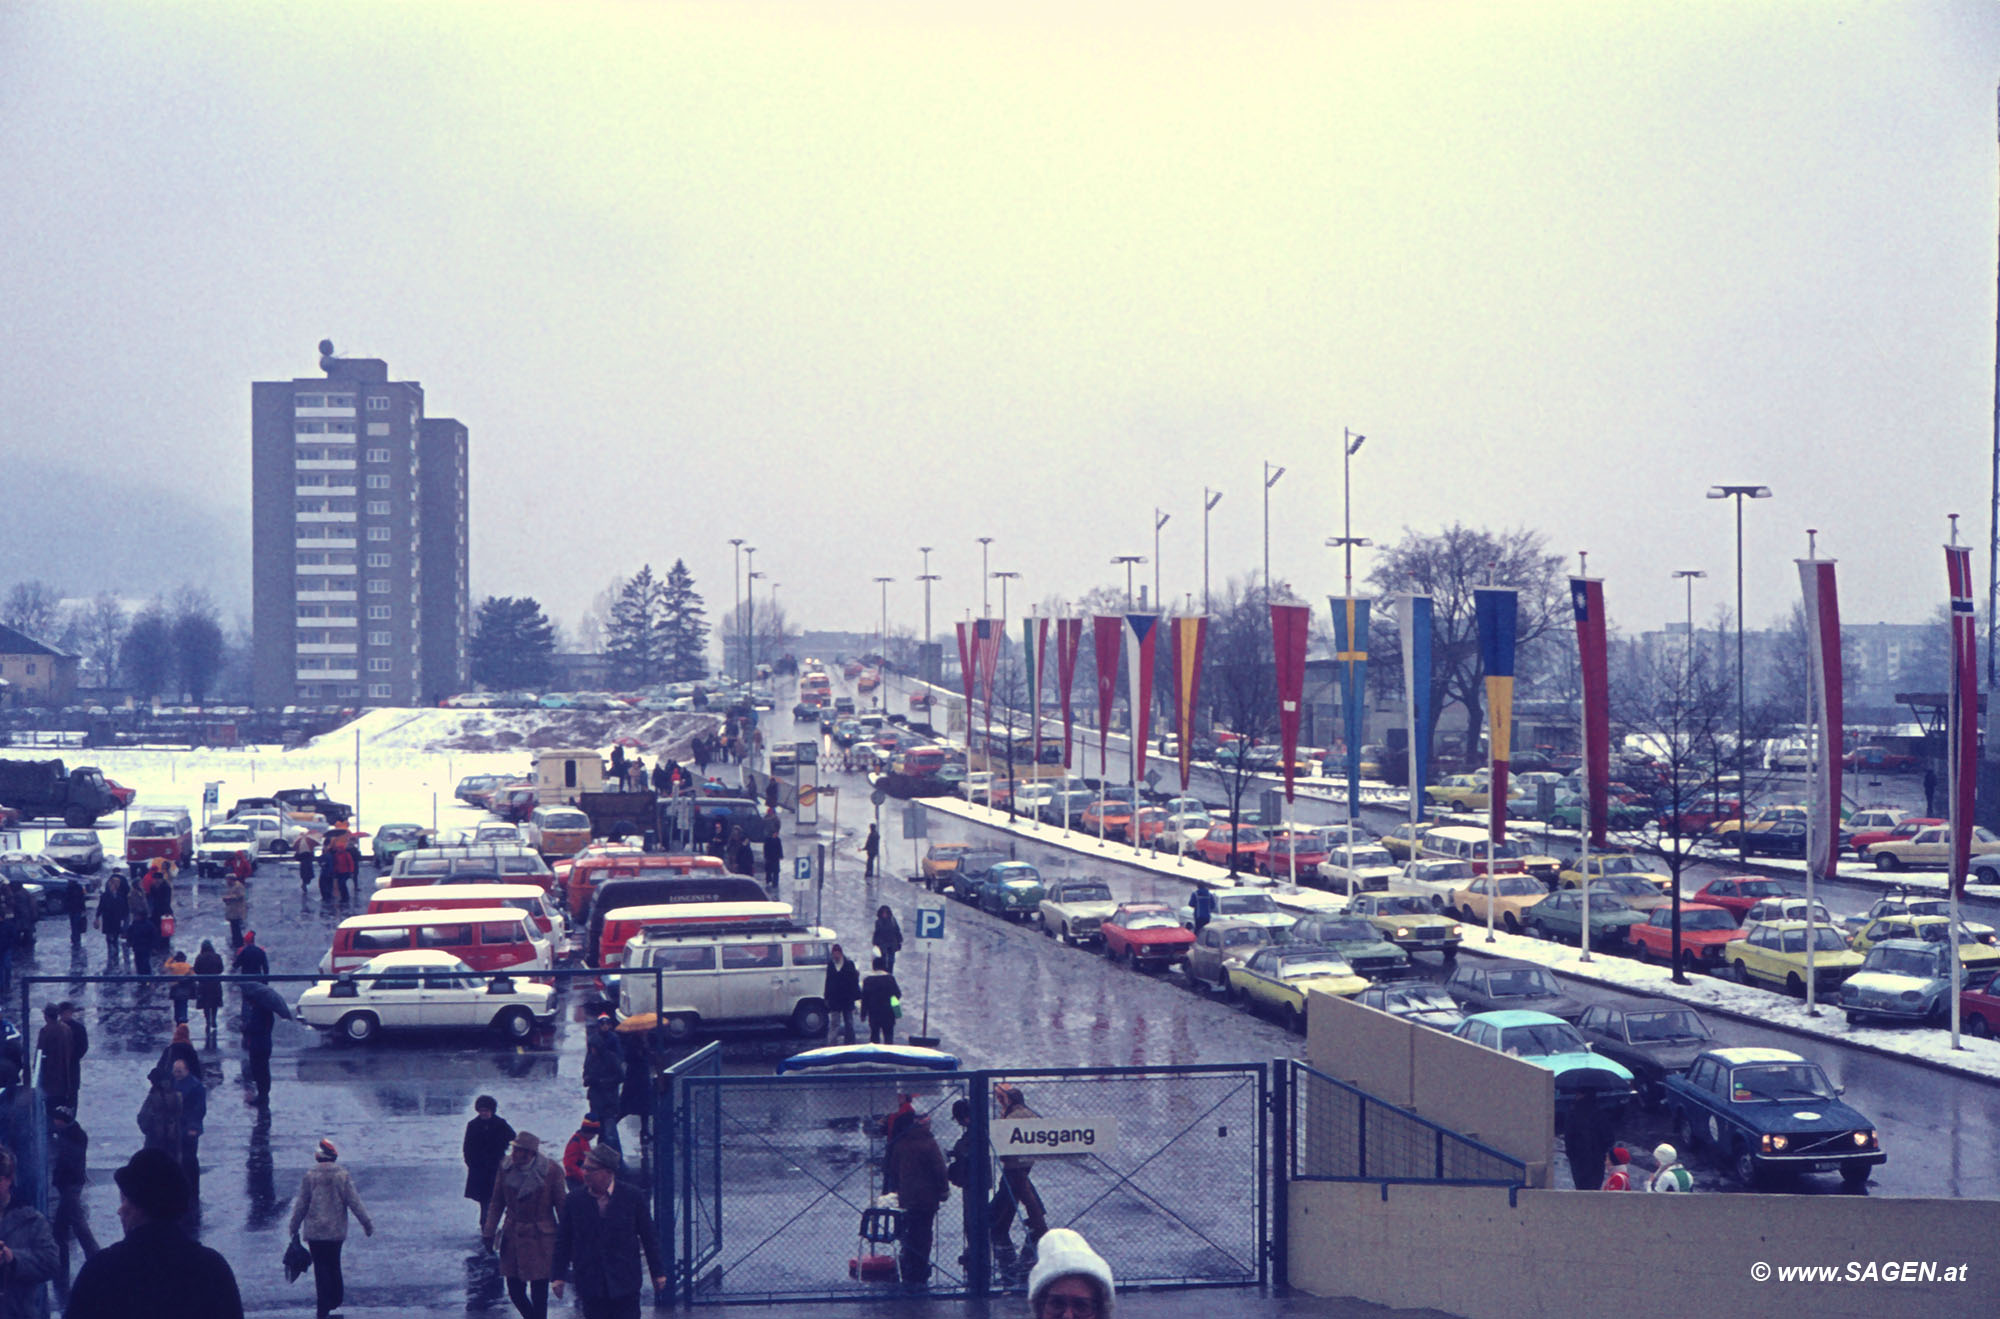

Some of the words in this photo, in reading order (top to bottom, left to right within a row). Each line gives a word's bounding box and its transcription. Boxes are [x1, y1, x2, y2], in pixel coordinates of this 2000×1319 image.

[206, 790, 216, 803] P
[798, 858, 810, 878] P
[921, 910, 941, 937] P
[1009, 1127, 1095, 1147] Ausgang
